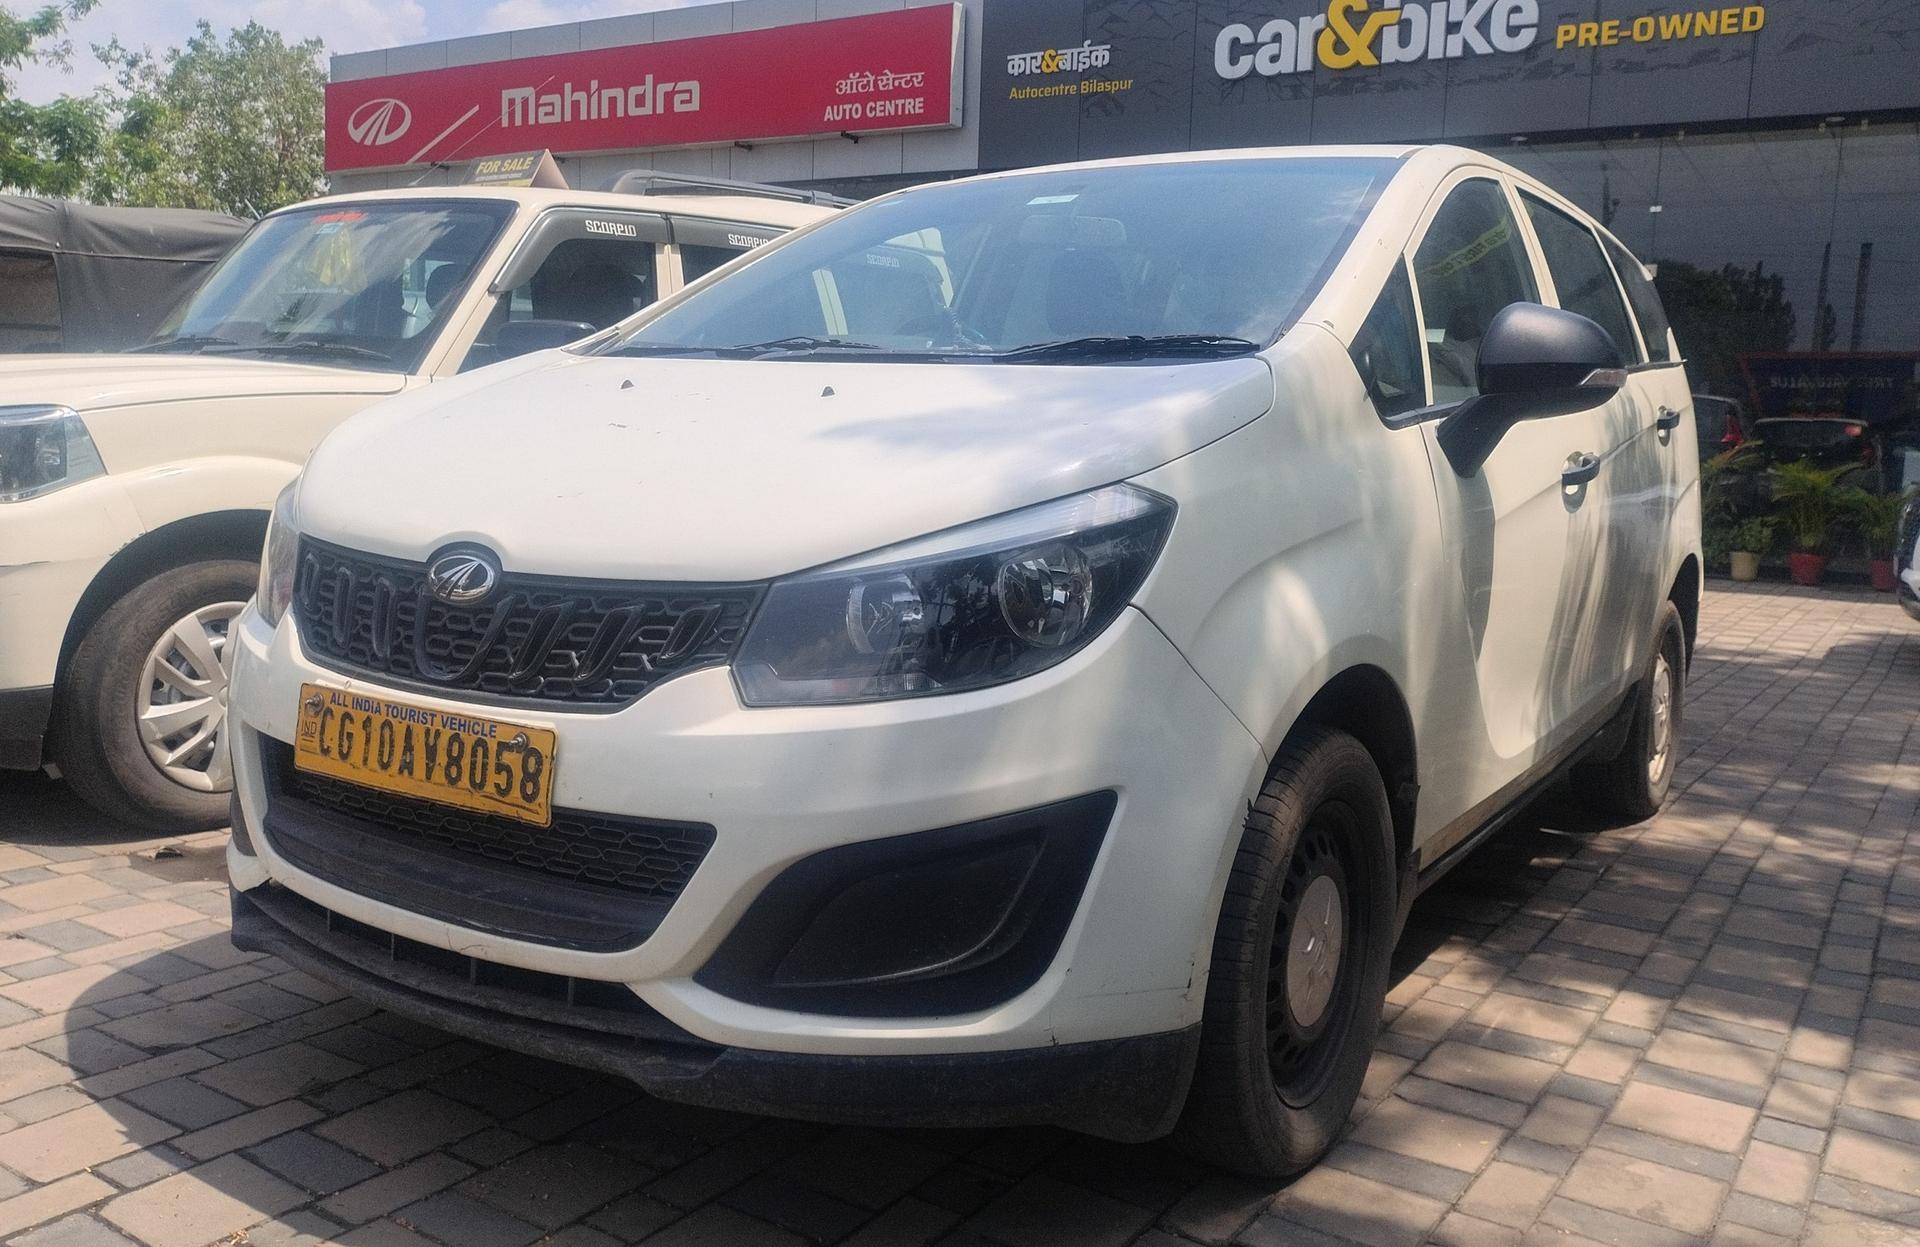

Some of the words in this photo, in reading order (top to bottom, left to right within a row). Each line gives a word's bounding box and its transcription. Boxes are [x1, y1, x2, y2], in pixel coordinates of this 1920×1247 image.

[1214, 0, 1540, 80] car&bike
[1556, 6, 1765, 49] PRE-OWNED
[835, 71, 875, 95] ऑटो
[1009, 83, 1077, 100] Autocentre
[1080, 79, 1133, 94] Bilaspur
[501, 74, 700, 128] Mahindra
[823, 103, 862, 121] AUTO
[866, 97, 924, 118] CENTRE
[476, 160, 500, 174] FOR
[502, 156, 534, 171] SALE
[585, 219, 637, 237] SCORPIO
[330, 692, 348, 708] ALL
[352, 697, 382, 716] INDIA
[385, 704, 437, 727] TOURIST
[441, 715, 498, 739] VEHICLE
[319, 707, 544, 804] CG10AV8058
